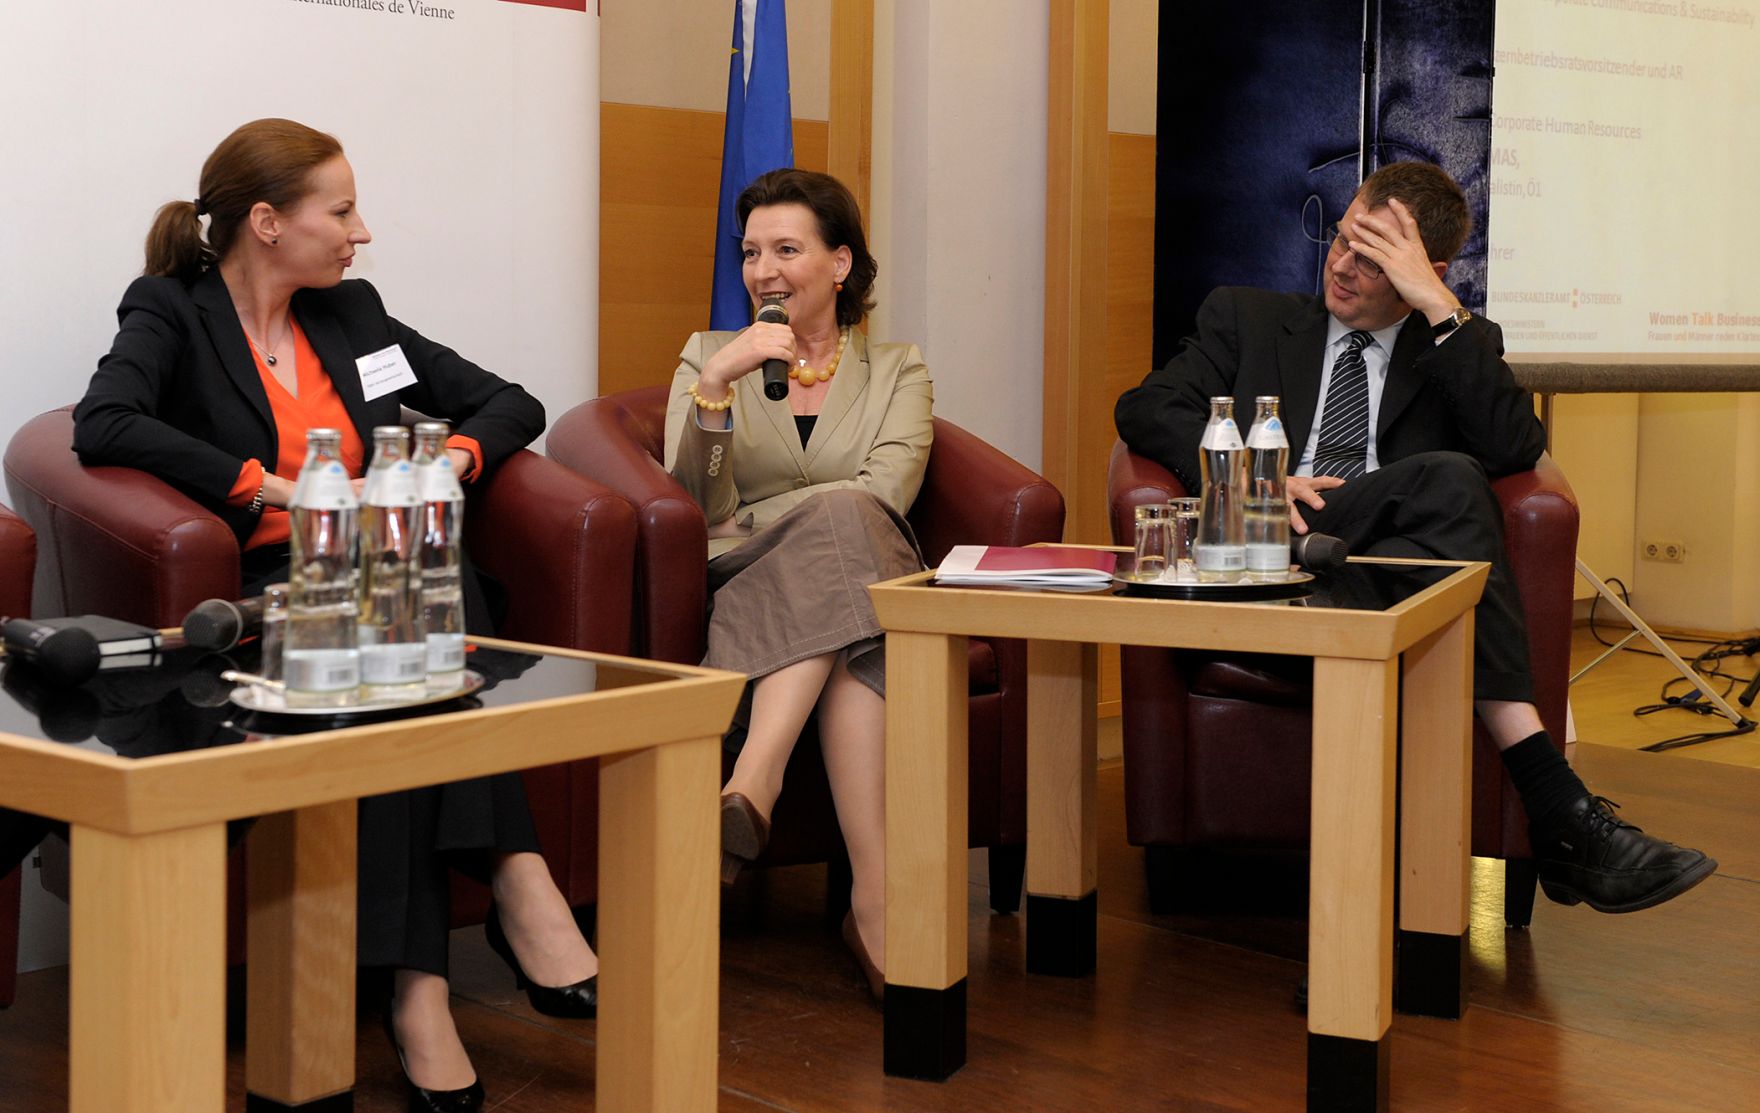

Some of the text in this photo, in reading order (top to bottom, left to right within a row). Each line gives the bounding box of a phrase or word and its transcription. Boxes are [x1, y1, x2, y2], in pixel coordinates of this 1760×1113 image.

[388, 0, 404, 14] de
[409, 0, 455, 20] Vienne
[1647, 63, 1667, 79] und
[1669, 65, 1684, 80] AR
[1545, 117, 1586, 136] Human
[1588, 120, 1642, 140] Resources
[1649, 312, 1688, 326] Women
[1692, 312, 1713, 327] Talk
